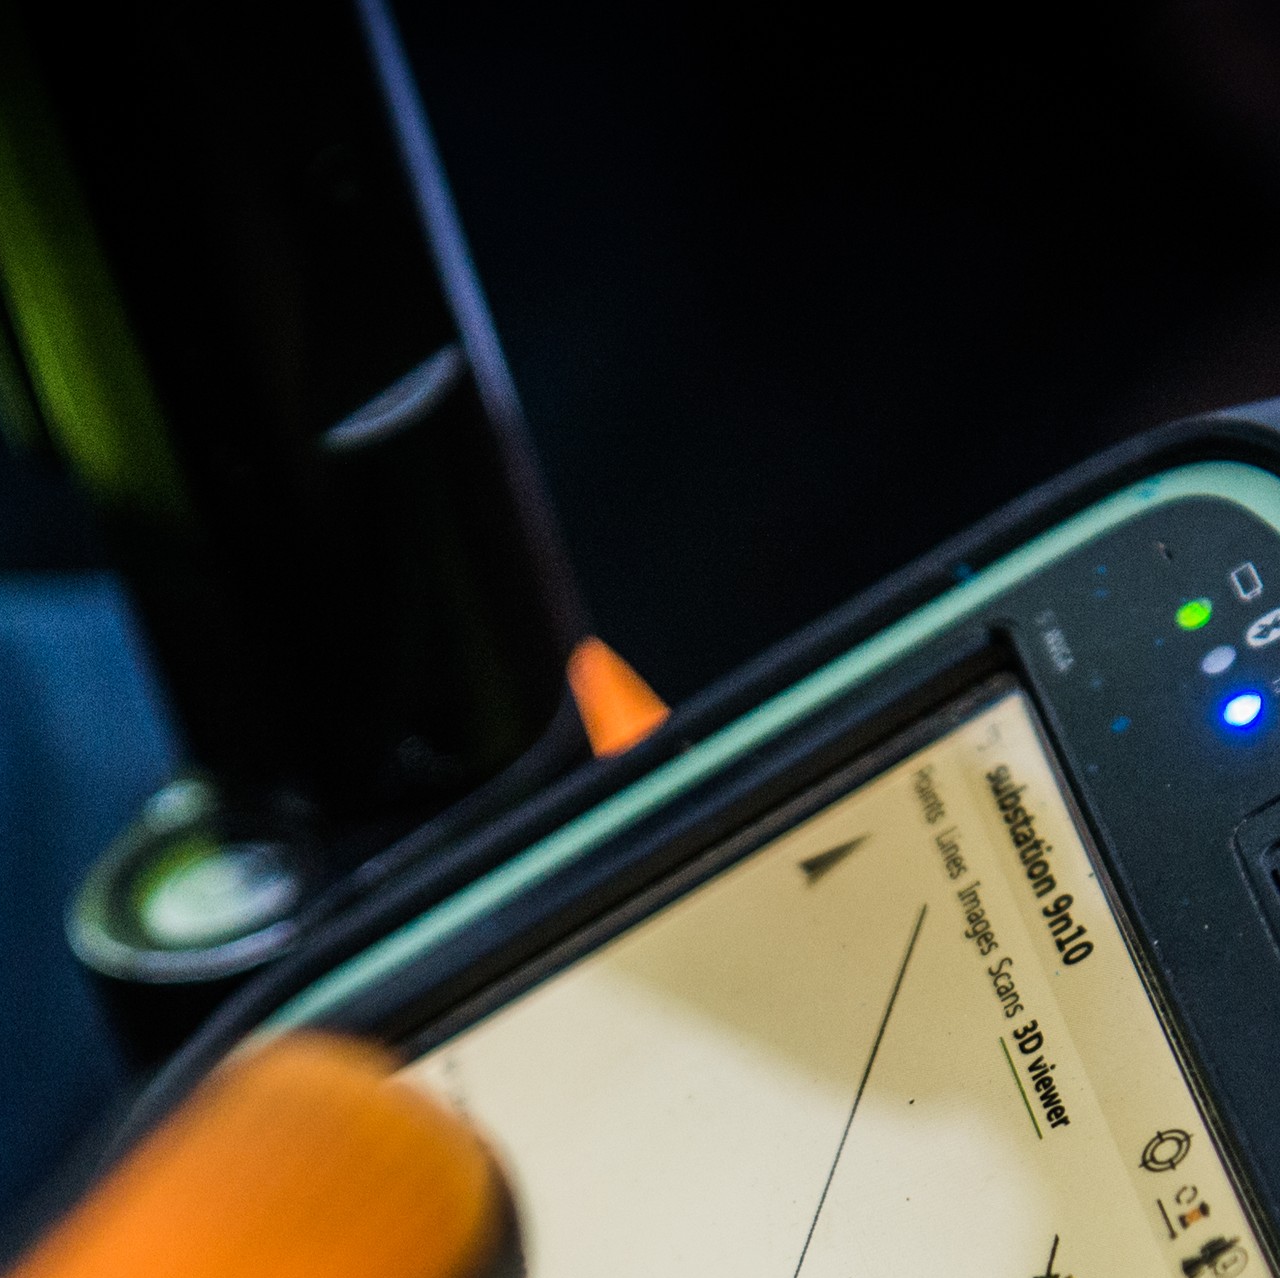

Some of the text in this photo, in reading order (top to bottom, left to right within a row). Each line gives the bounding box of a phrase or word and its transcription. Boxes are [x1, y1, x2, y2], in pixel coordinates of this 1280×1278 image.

[912, 763, 1070, 1129] Points Lines Images Scans 3D viewer
[986, 764, 1094, 966] substation 9n10
